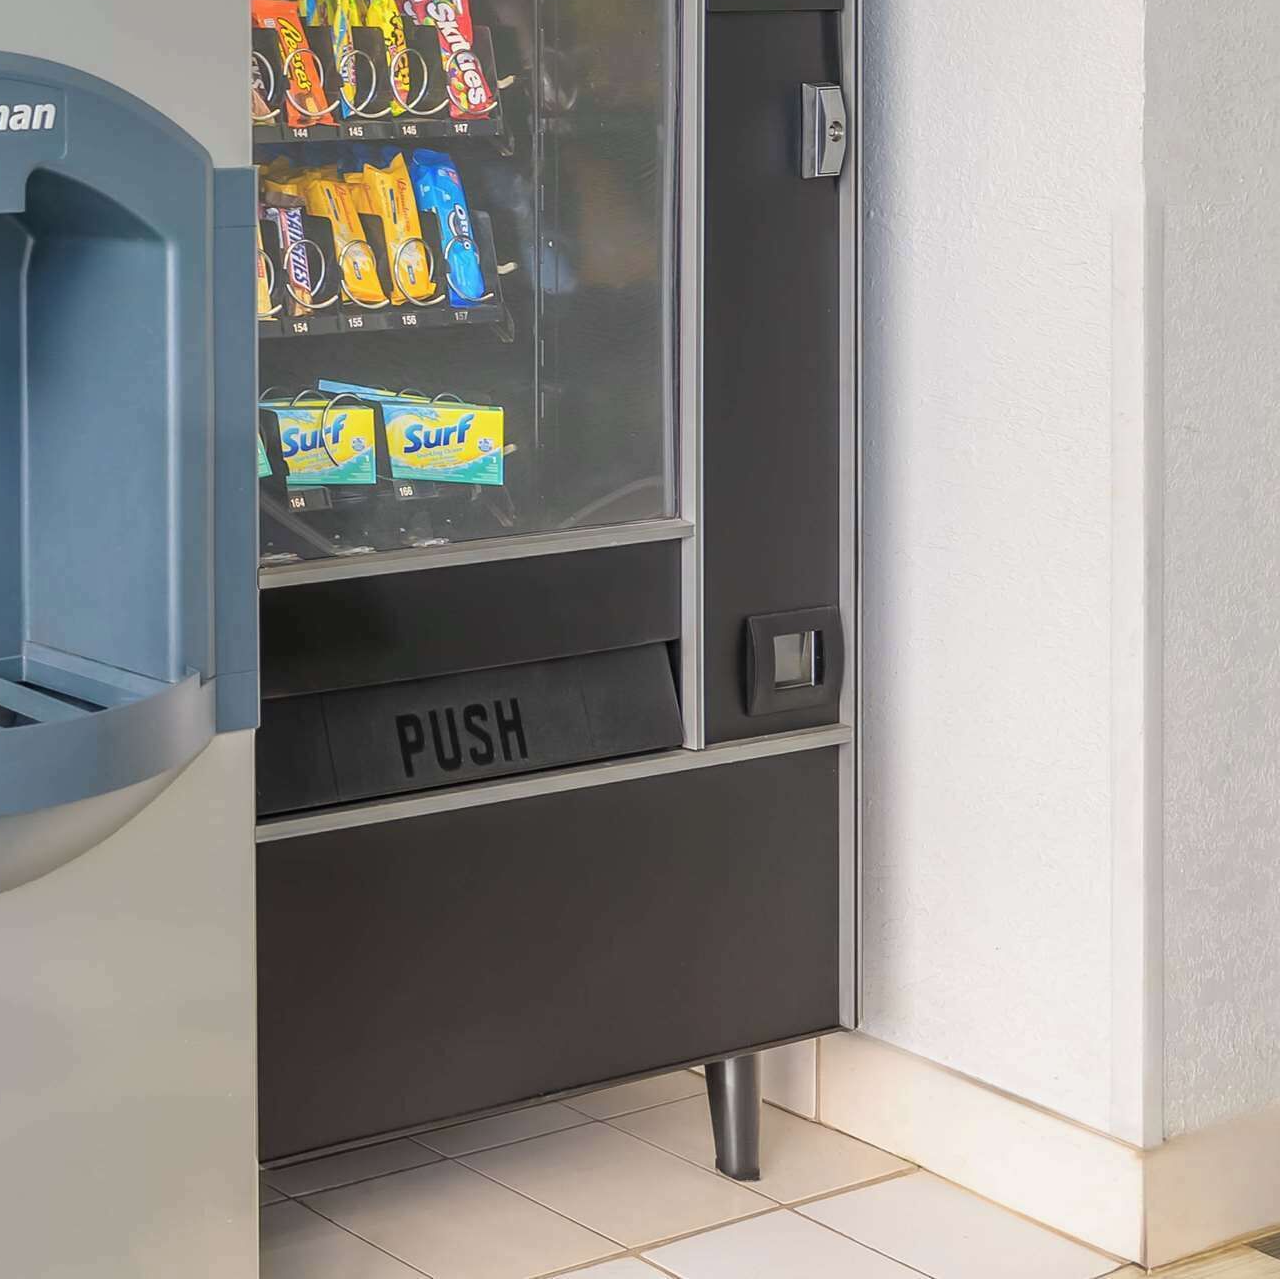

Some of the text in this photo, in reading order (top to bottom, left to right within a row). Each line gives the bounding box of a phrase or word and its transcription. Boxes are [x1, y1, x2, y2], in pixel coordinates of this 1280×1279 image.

[292, 128, 308, 138] 144
[348, 127, 363, 137] 145
[454, 123, 468, 133] 147
[348, 317, 363, 328] 155
[293, 323, 308, 333] 154
[282, 414, 348, 458] Surf
[404, 414, 475, 453] Surf
[394, 697, 529, 778] PUSH
